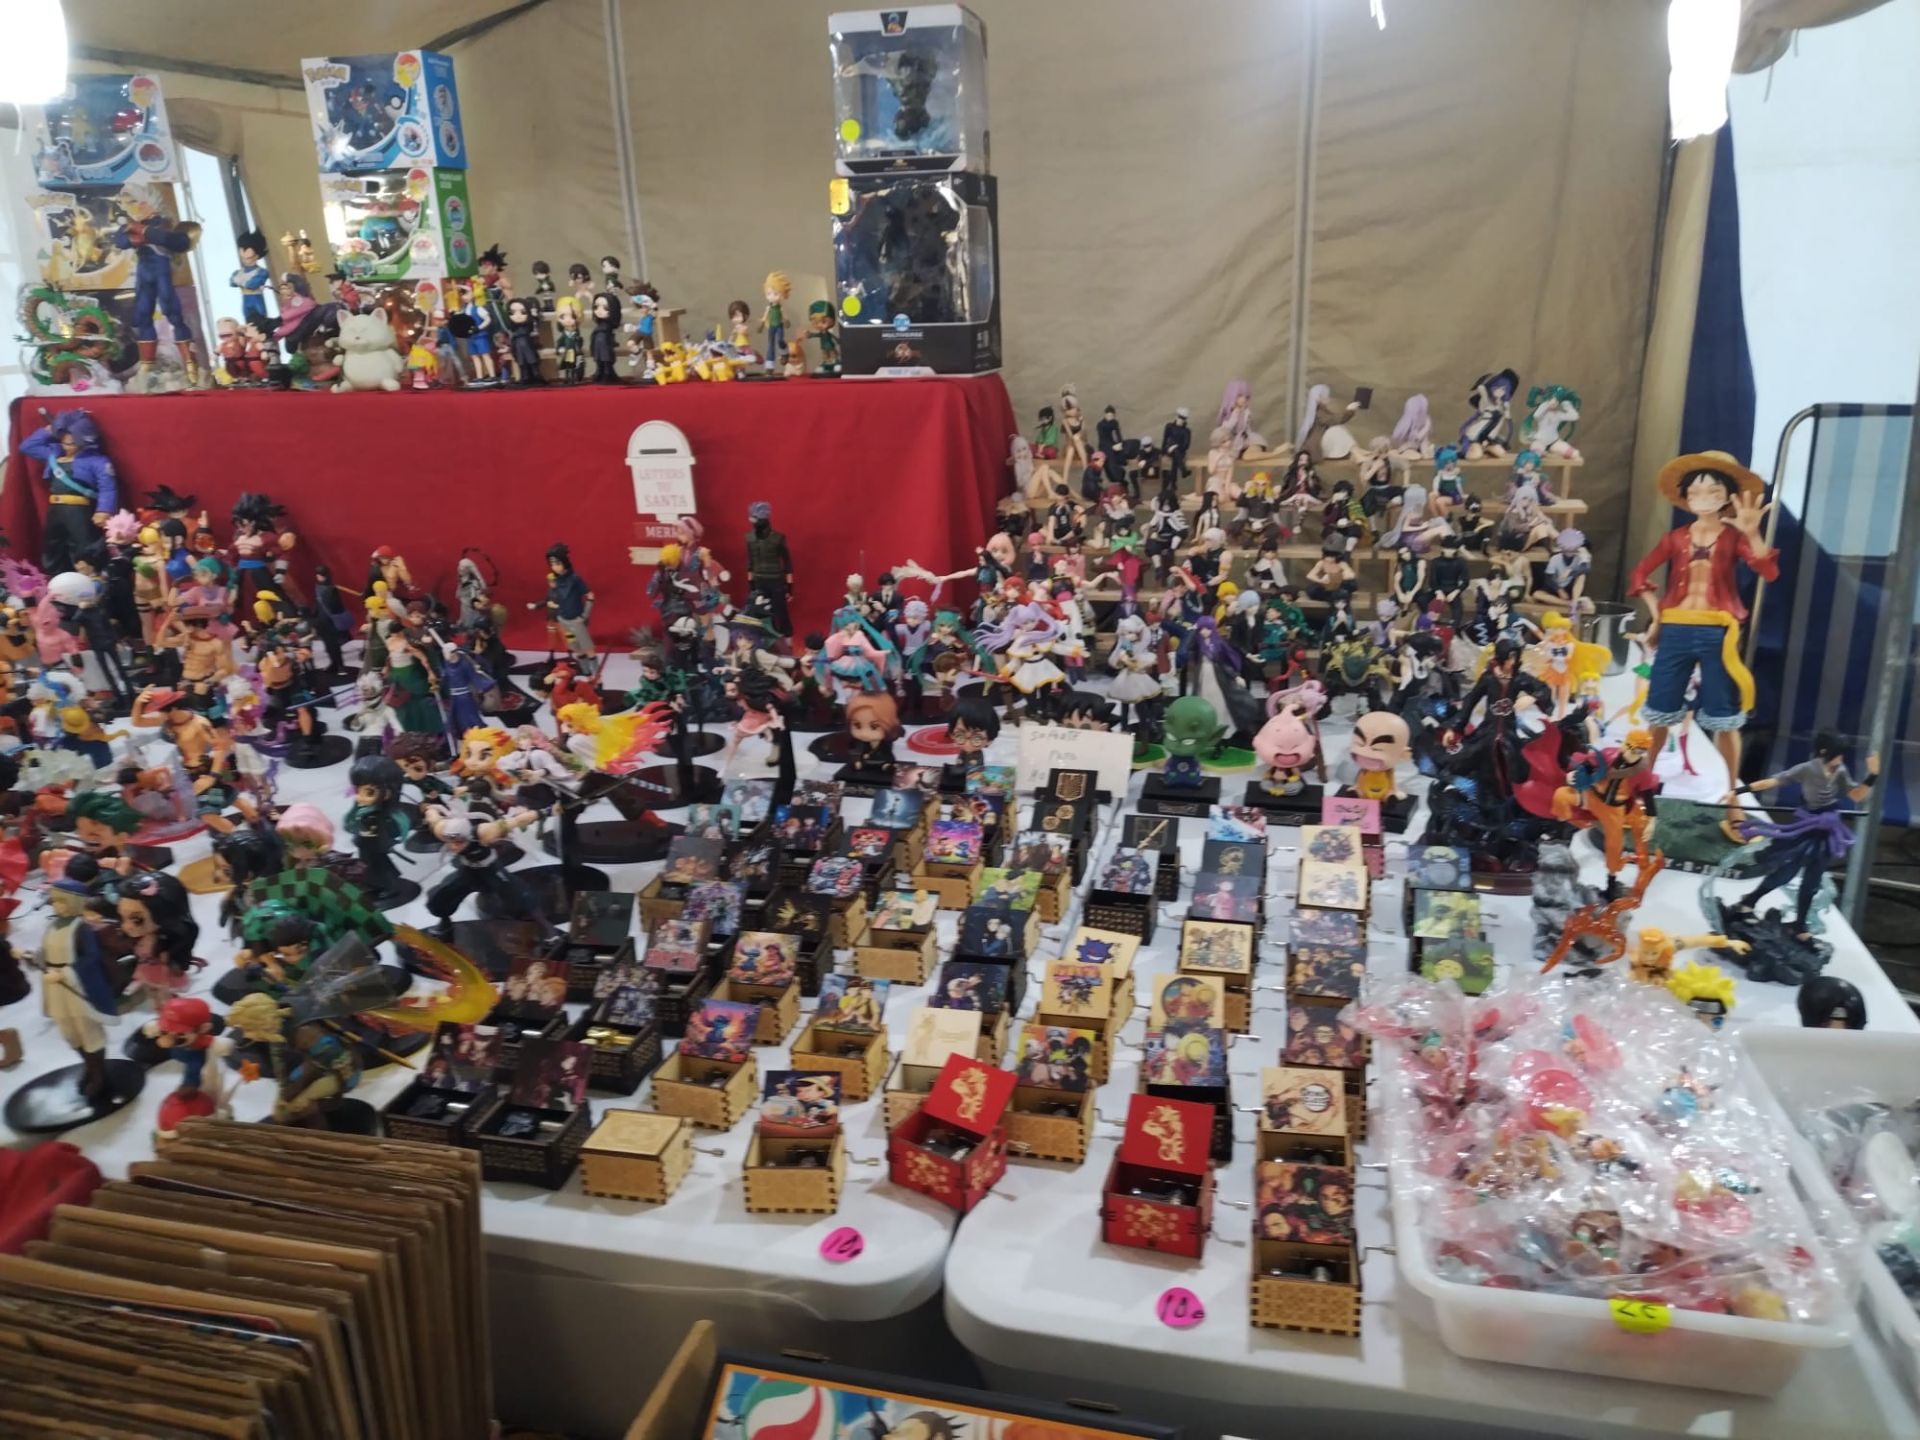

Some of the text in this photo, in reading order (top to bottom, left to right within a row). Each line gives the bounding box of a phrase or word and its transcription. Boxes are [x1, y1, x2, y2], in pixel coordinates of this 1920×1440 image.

[638, 469, 685, 480] LETTERS
[655, 481, 671, 492] TO
[644, 494, 688, 507] SANTA
